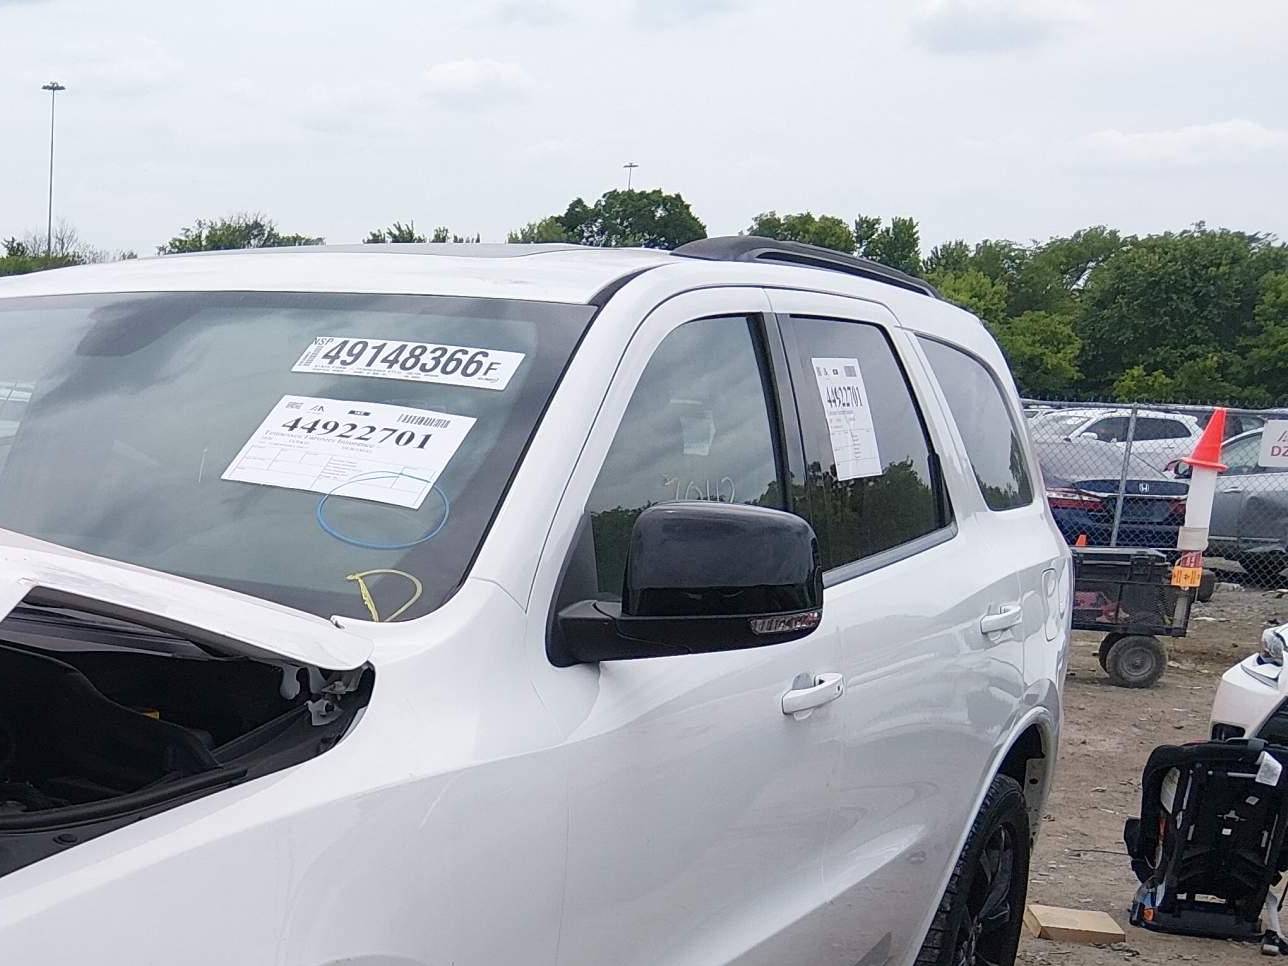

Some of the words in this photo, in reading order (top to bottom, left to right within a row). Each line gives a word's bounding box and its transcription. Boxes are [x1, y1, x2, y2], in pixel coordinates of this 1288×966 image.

[321, 339, 489, 377] 49148366
[483, 362, 502, 376] F
[281, 416, 432, 450] 44922701
